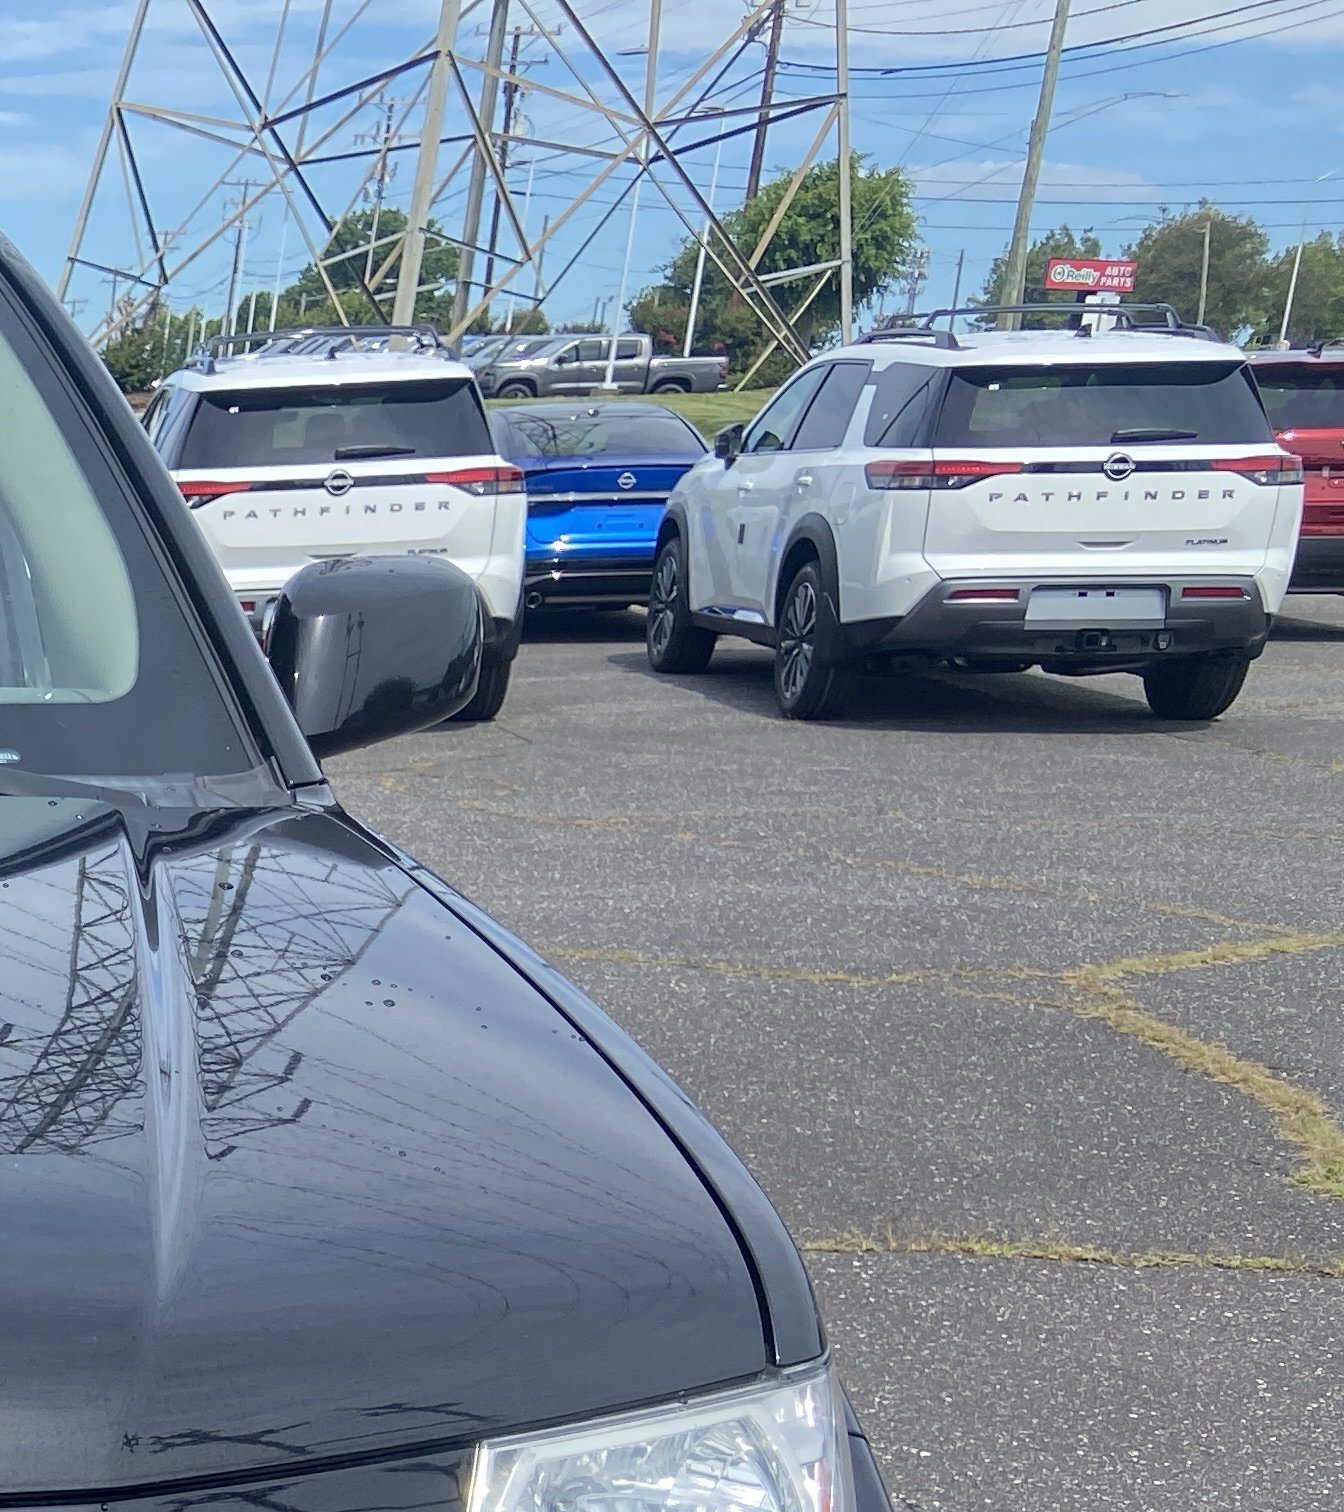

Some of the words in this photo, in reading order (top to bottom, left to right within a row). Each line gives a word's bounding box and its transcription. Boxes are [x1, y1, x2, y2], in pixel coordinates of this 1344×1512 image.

[1052, 264, 1099, 284] O'Reilly
[1105, 266, 1132, 277] AUTO
[1100, 276, 1132, 288] PARTS
[988, 488, 1235, 503] PATHFINDER
[222, 500, 451, 521] PATHFINDER
